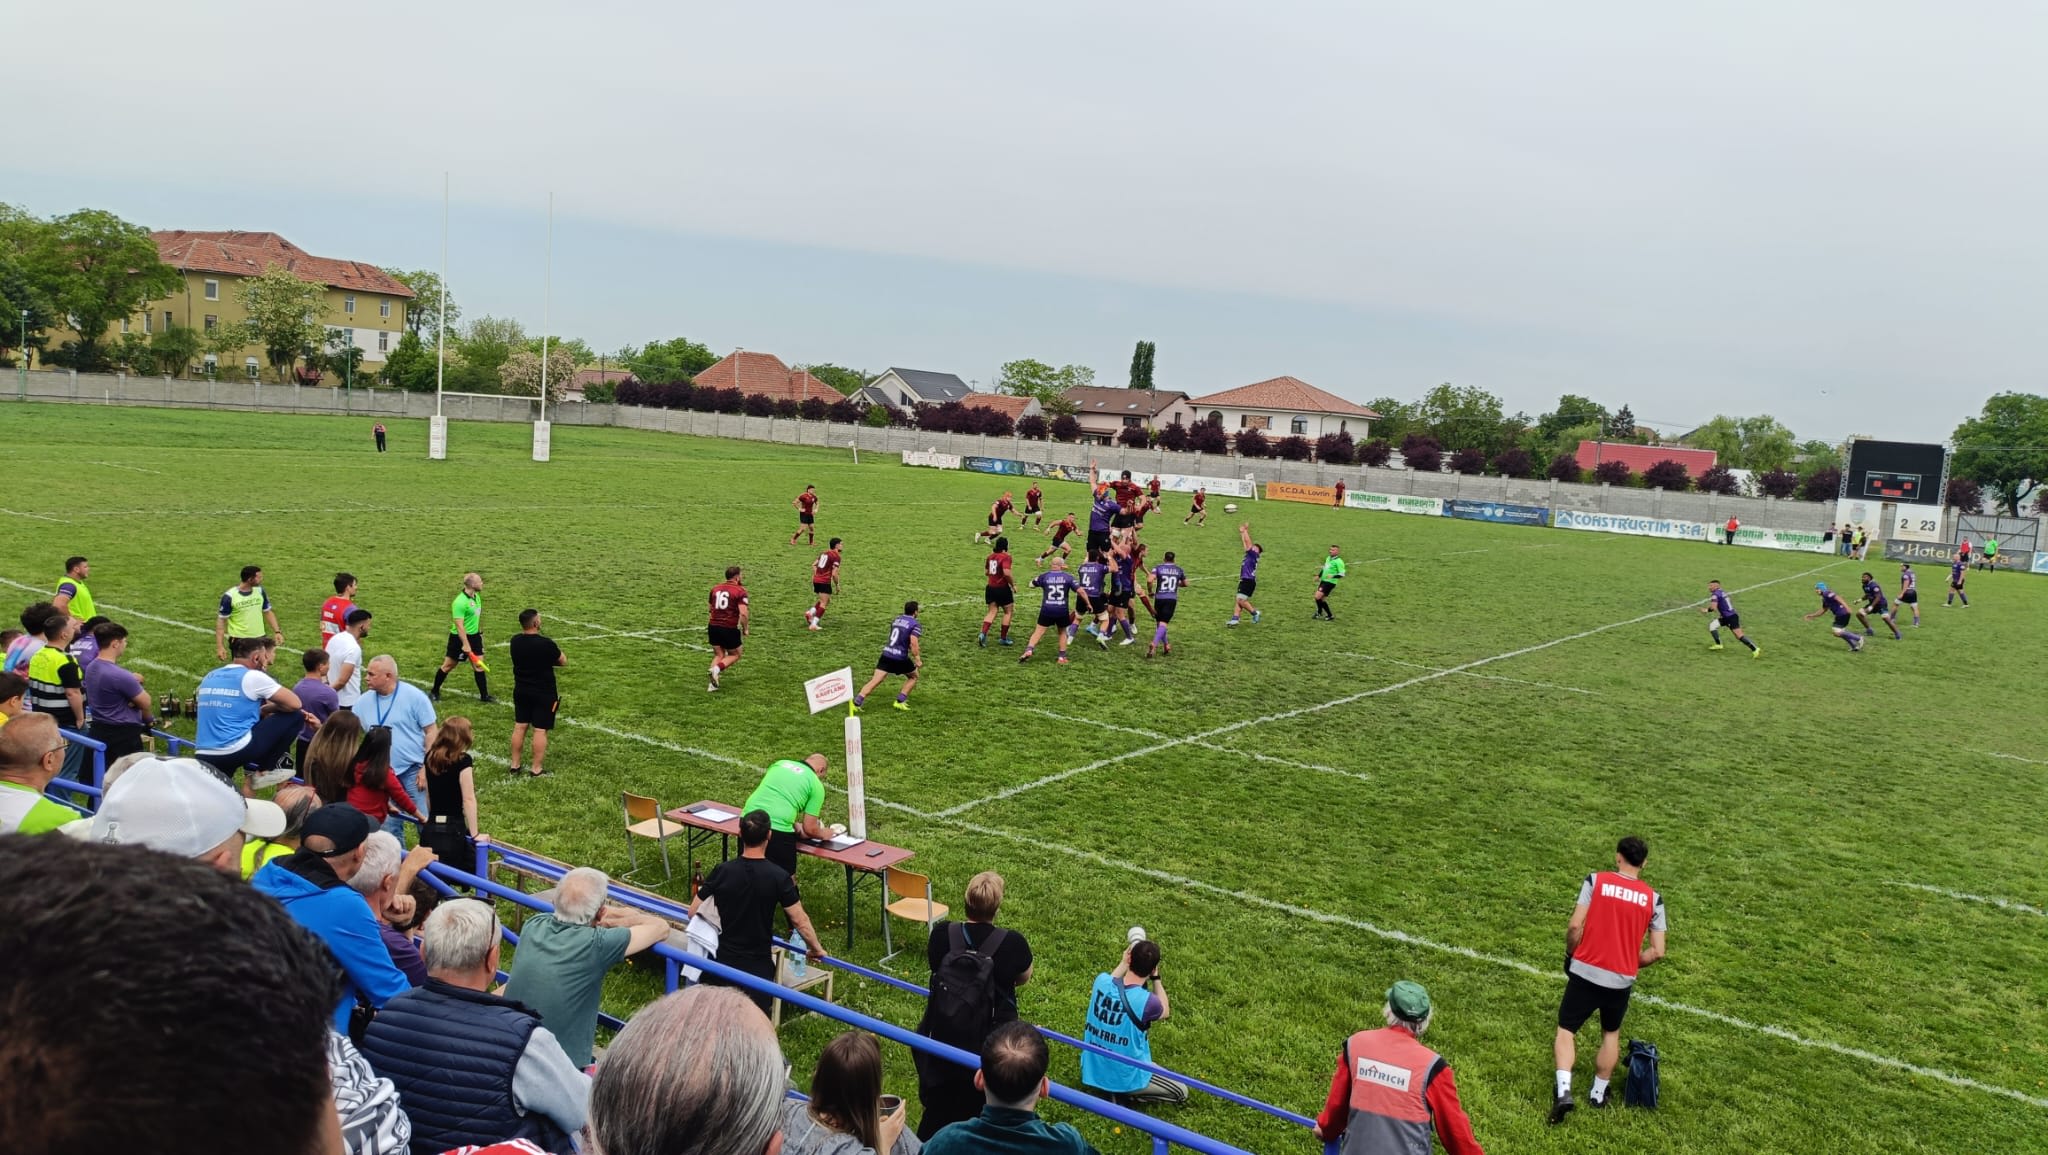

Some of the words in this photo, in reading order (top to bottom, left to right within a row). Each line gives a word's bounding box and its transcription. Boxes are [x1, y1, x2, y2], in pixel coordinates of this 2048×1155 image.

[1574, 514, 1670, 533] CONSTRUCTIM
[1900, 518, 1909, 529] 2
[1919, 520, 1936, 532] 23
[1905, 543, 1951, 559] Hotel
[989, 560, 998, 575] 18
[1082, 573, 1091, 587] 4
[1161, 575, 1177, 591] 20
[714, 591, 730, 610] 16
[1048, 584, 1065, 601] 25
[889, 627, 900, 646] 9
[1601, 883, 1648, 907] MEDIC
[1359, 1066, 1405, 1086] DITTRICH
